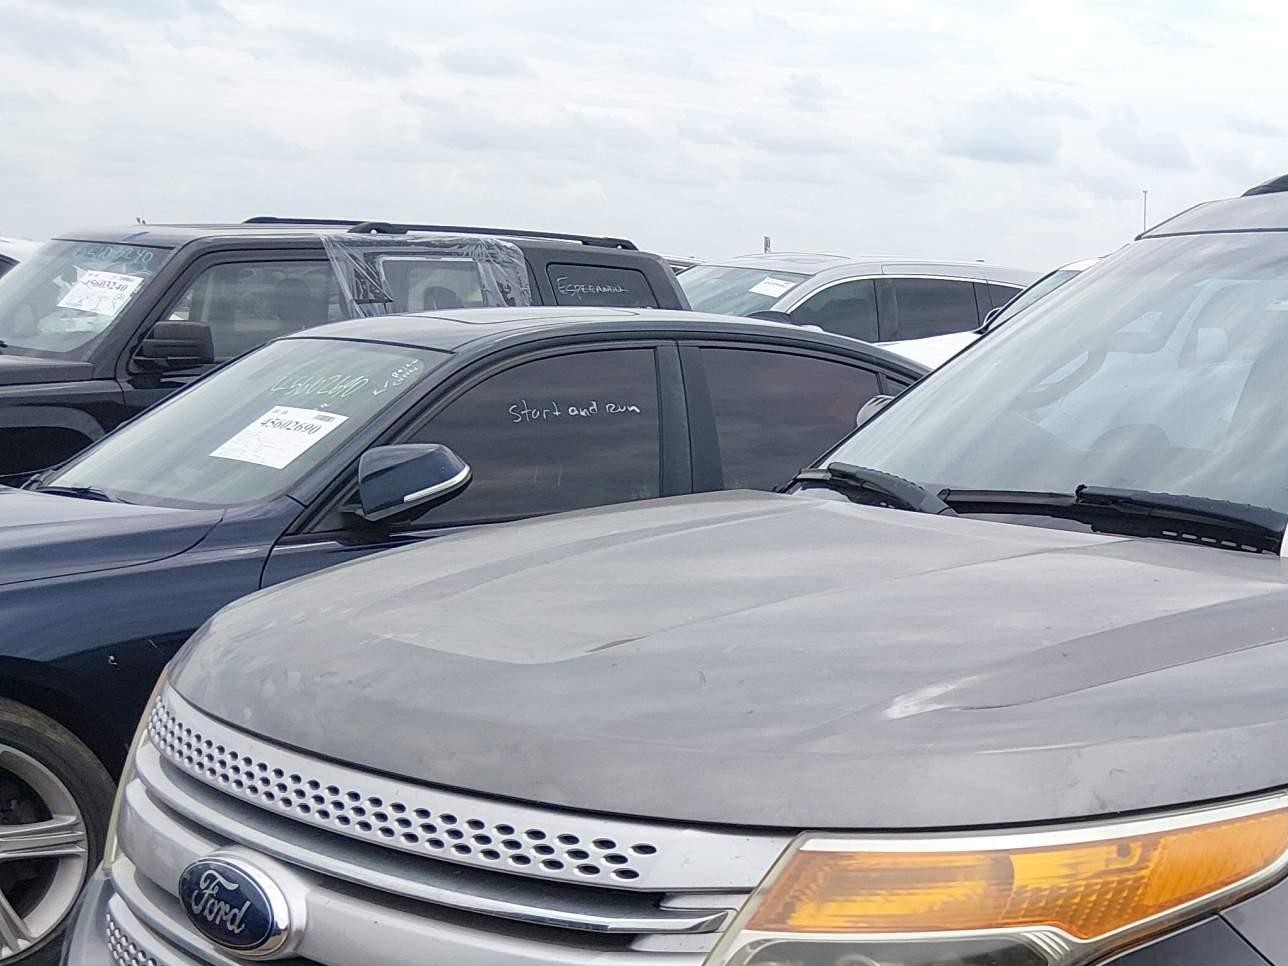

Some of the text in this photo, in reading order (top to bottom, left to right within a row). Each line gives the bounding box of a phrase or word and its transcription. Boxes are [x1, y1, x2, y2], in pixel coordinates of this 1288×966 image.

[568, 401, 598, 417] and
[260, 417, 323, 435] 45602690
[191, 869, 251, 934] Ford
